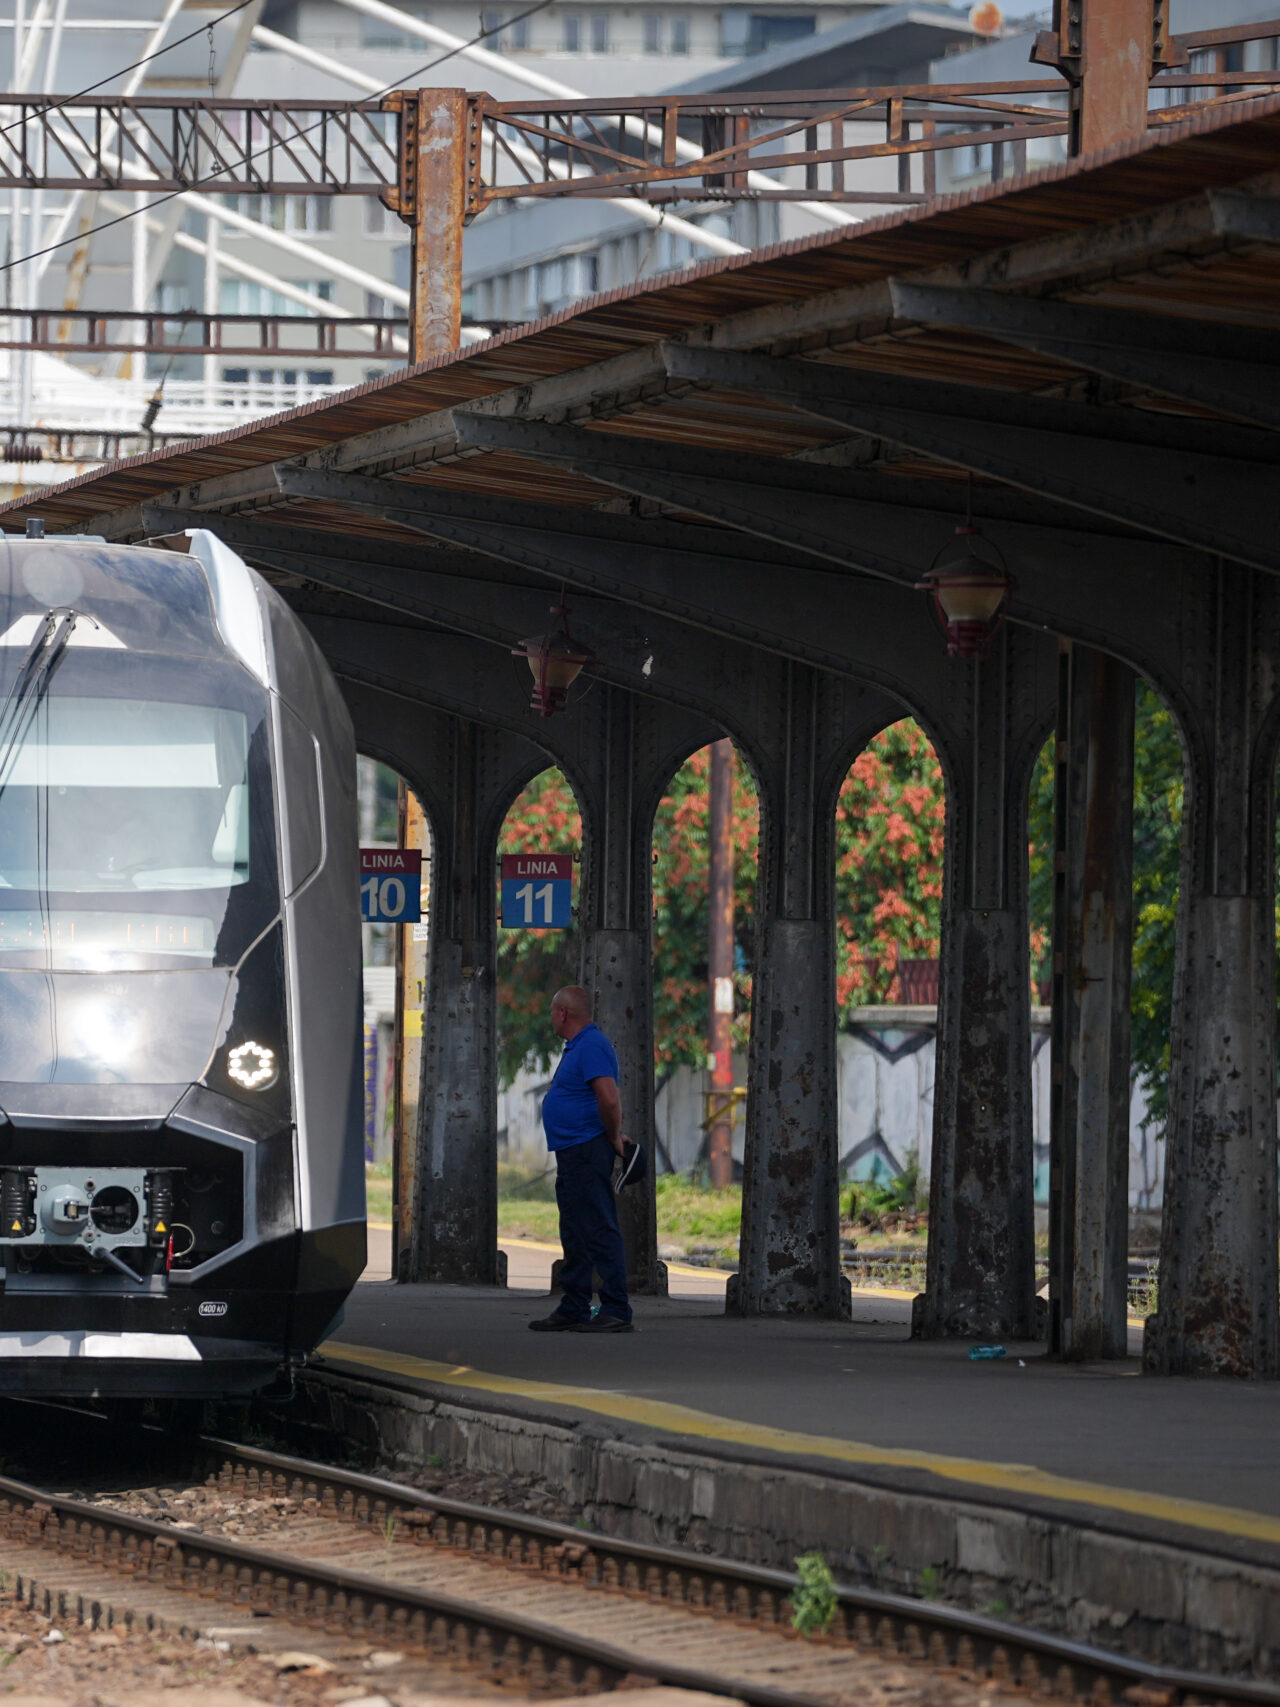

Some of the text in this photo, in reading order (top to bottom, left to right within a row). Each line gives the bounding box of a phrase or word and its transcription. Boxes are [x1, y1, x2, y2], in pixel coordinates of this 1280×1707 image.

[362, 854, 405, 869] LINIA
[517, 861, 558, 875] LINIA
[361, 876, 406, 918] 10
[515, 882, 554, 924] 11
